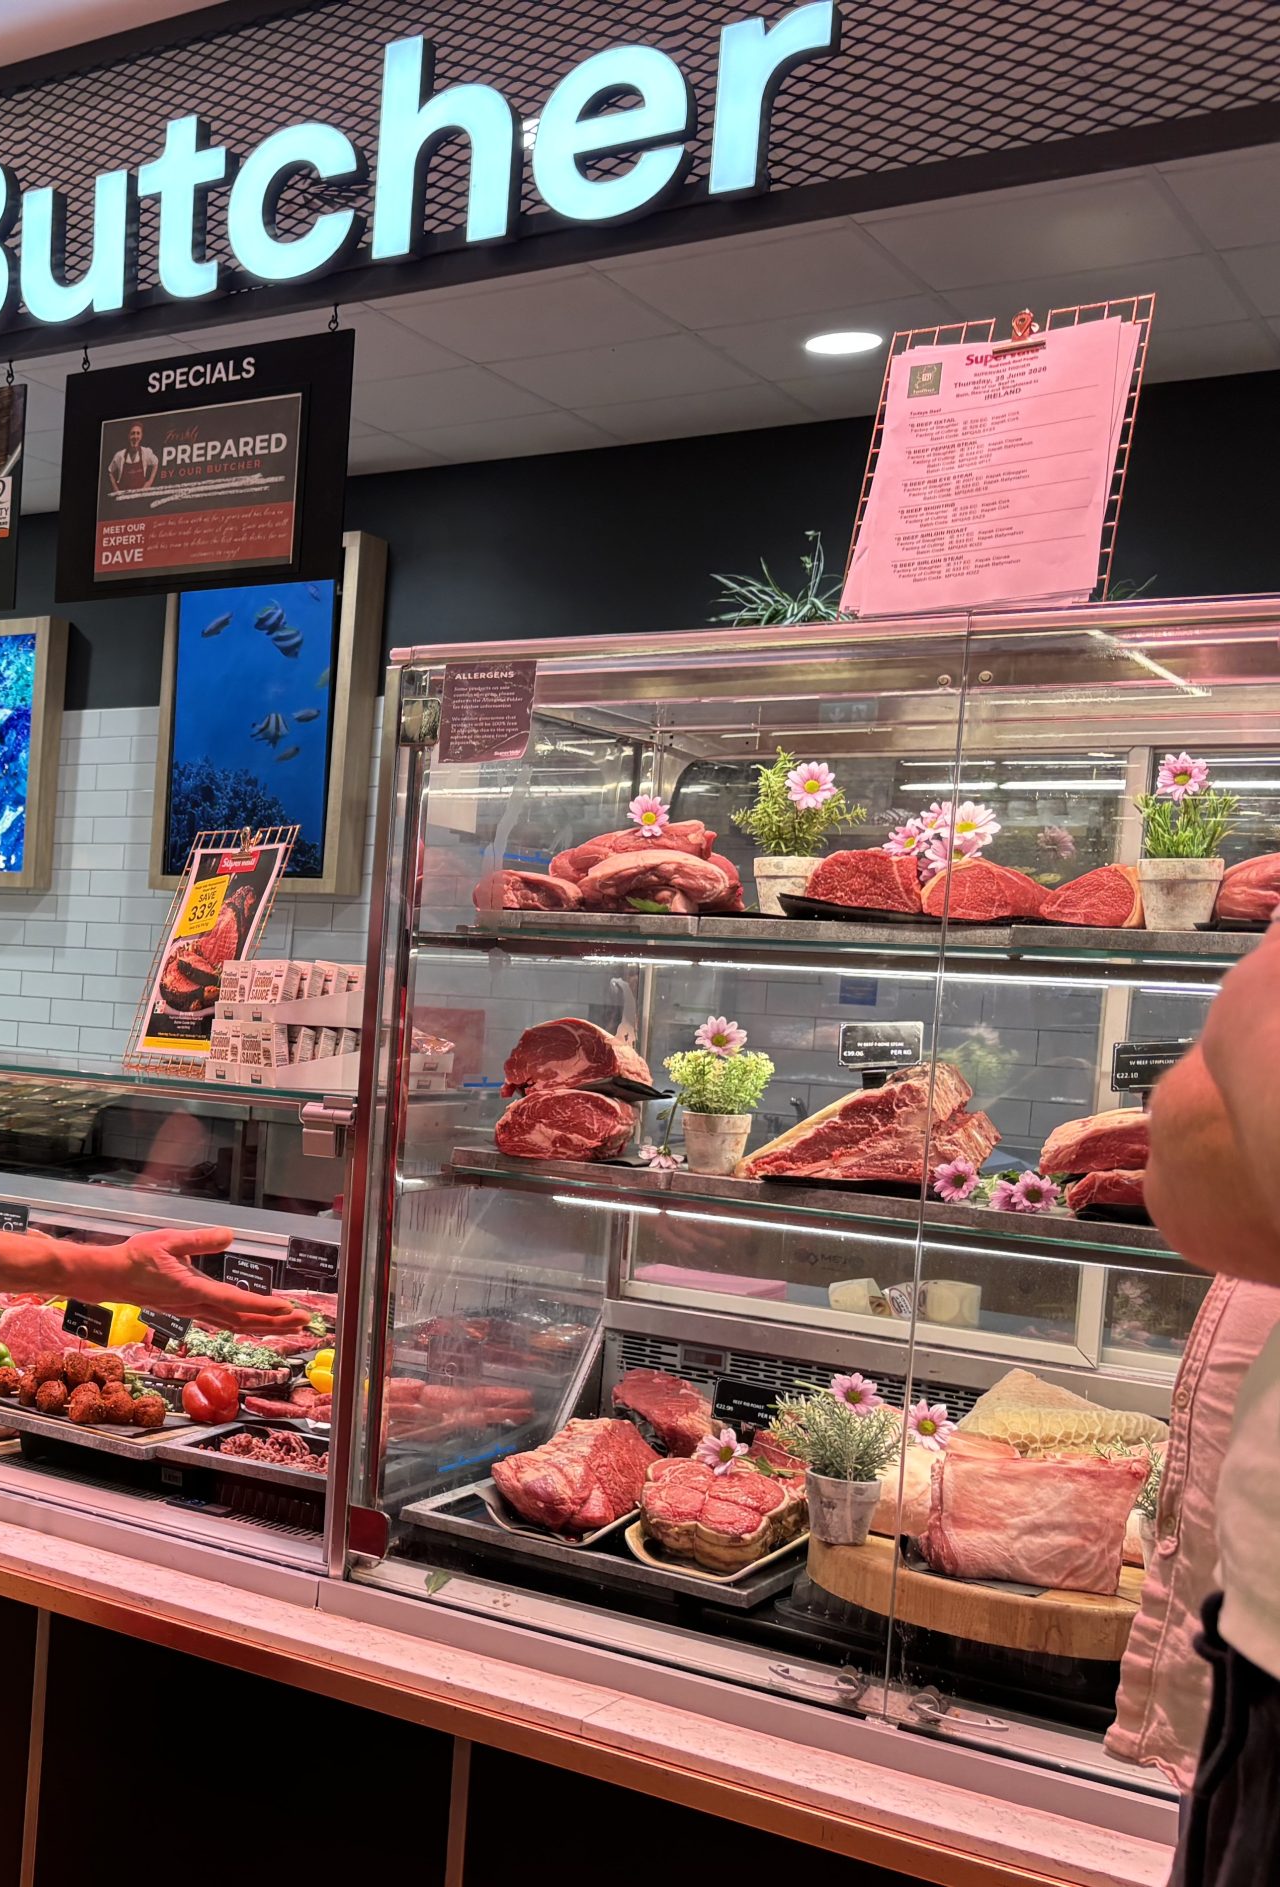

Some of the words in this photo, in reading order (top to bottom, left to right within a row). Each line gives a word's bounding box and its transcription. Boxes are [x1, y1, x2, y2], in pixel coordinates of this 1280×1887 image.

[148, 357, 256, 393] SPECIALS
[1007, 371, 1025, 380] June
[985, 388, 1022, 400] IRELAND
[162, 433, 287, 467] PREPARED
[161, 470, 174, 479] BY
[180, 467, 202, 477] OUR
[207, 459, 261, 473] BUTCHER
[103, 525, 125, 535] MEET
[127, 523, 145, 532] OUR
[103, 535, 144, 547] EXPERT:
[102, 549, 143, 565] DAVE
[455, 671, 514, 680] ALLERGENS
[198, 890, 217, 902] SAVE
[188, 901, 217, 921] 33%
[220, 990, 237, 1000] SAUCE
[250, 989, 270, 1000] SAUCE
[210, 1048, 229, 1060] SAUCE
[242, 1053, 261, 1065] SAUCE
